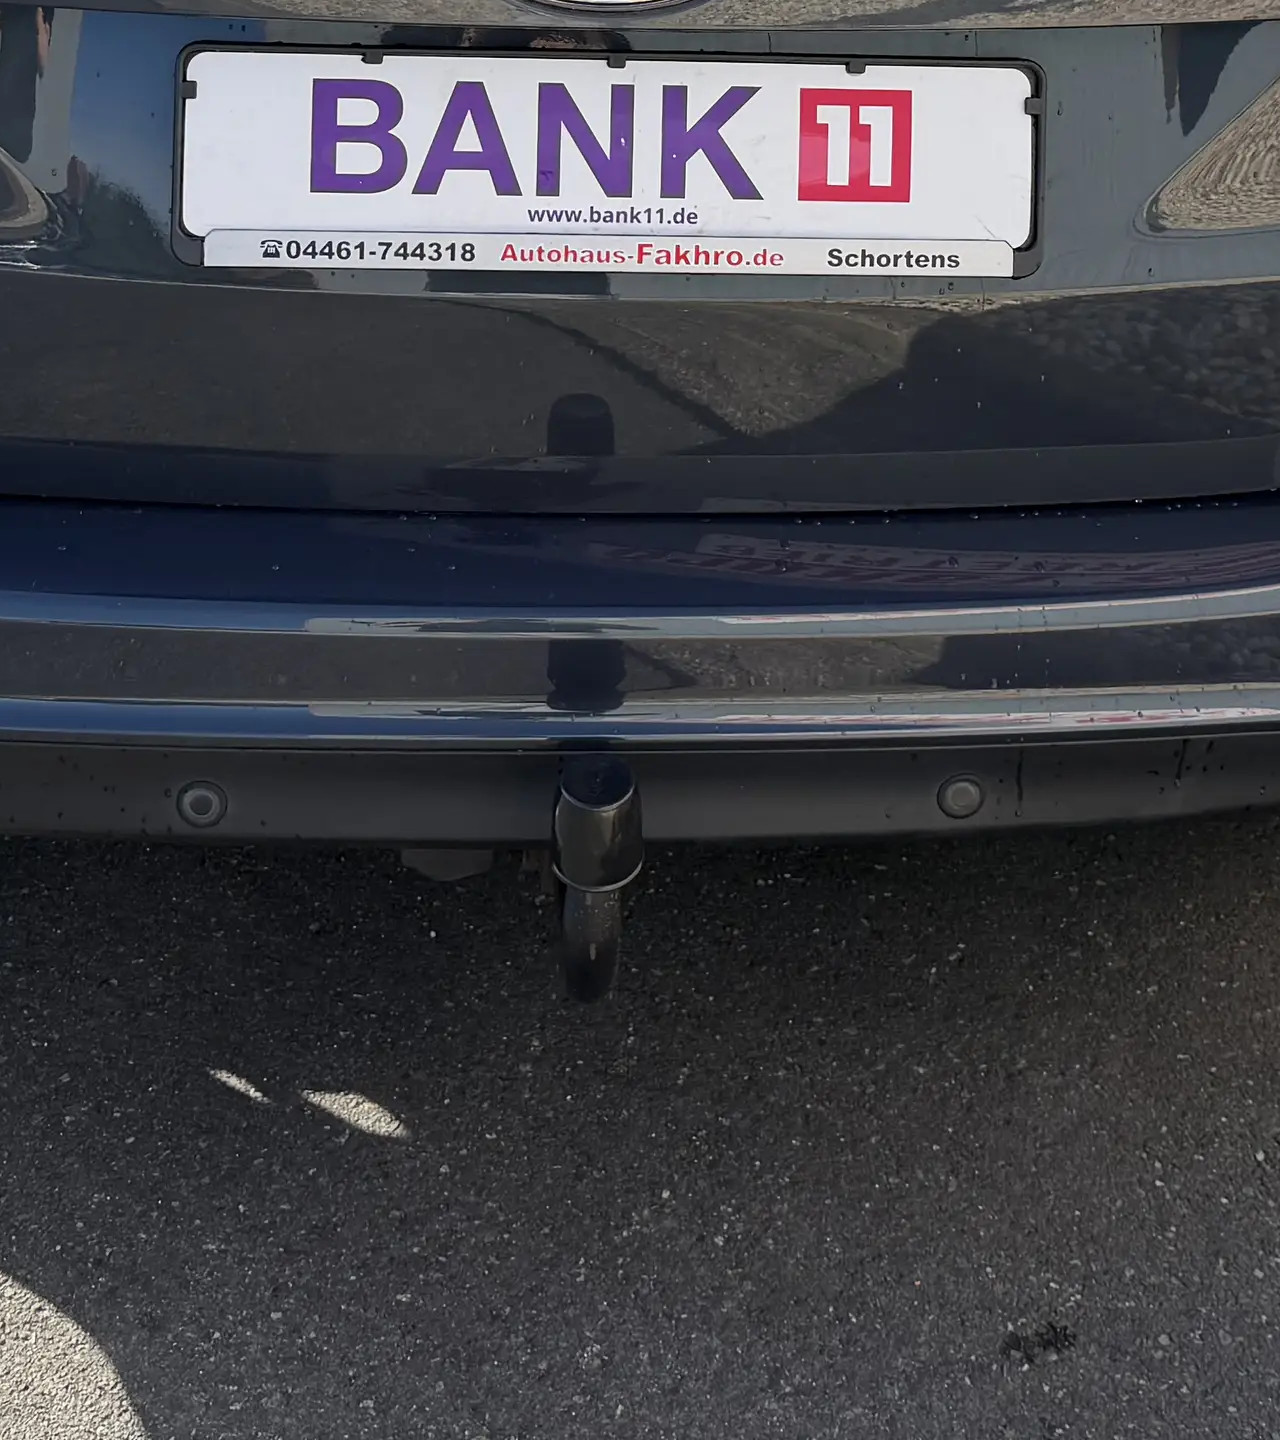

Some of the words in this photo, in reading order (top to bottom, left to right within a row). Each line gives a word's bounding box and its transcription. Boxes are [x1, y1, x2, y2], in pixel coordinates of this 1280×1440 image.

[309, 78, 764, 201] BANK
[813, 102, 896, 190] 11
[527, 206, 699, 225] www.bank11.de
[285, 240, 476, 262] 04461-744318
[500, 243, 784, 267] Autohaus-Fakhro.de
[827, 247, 961, 269] Schortens
